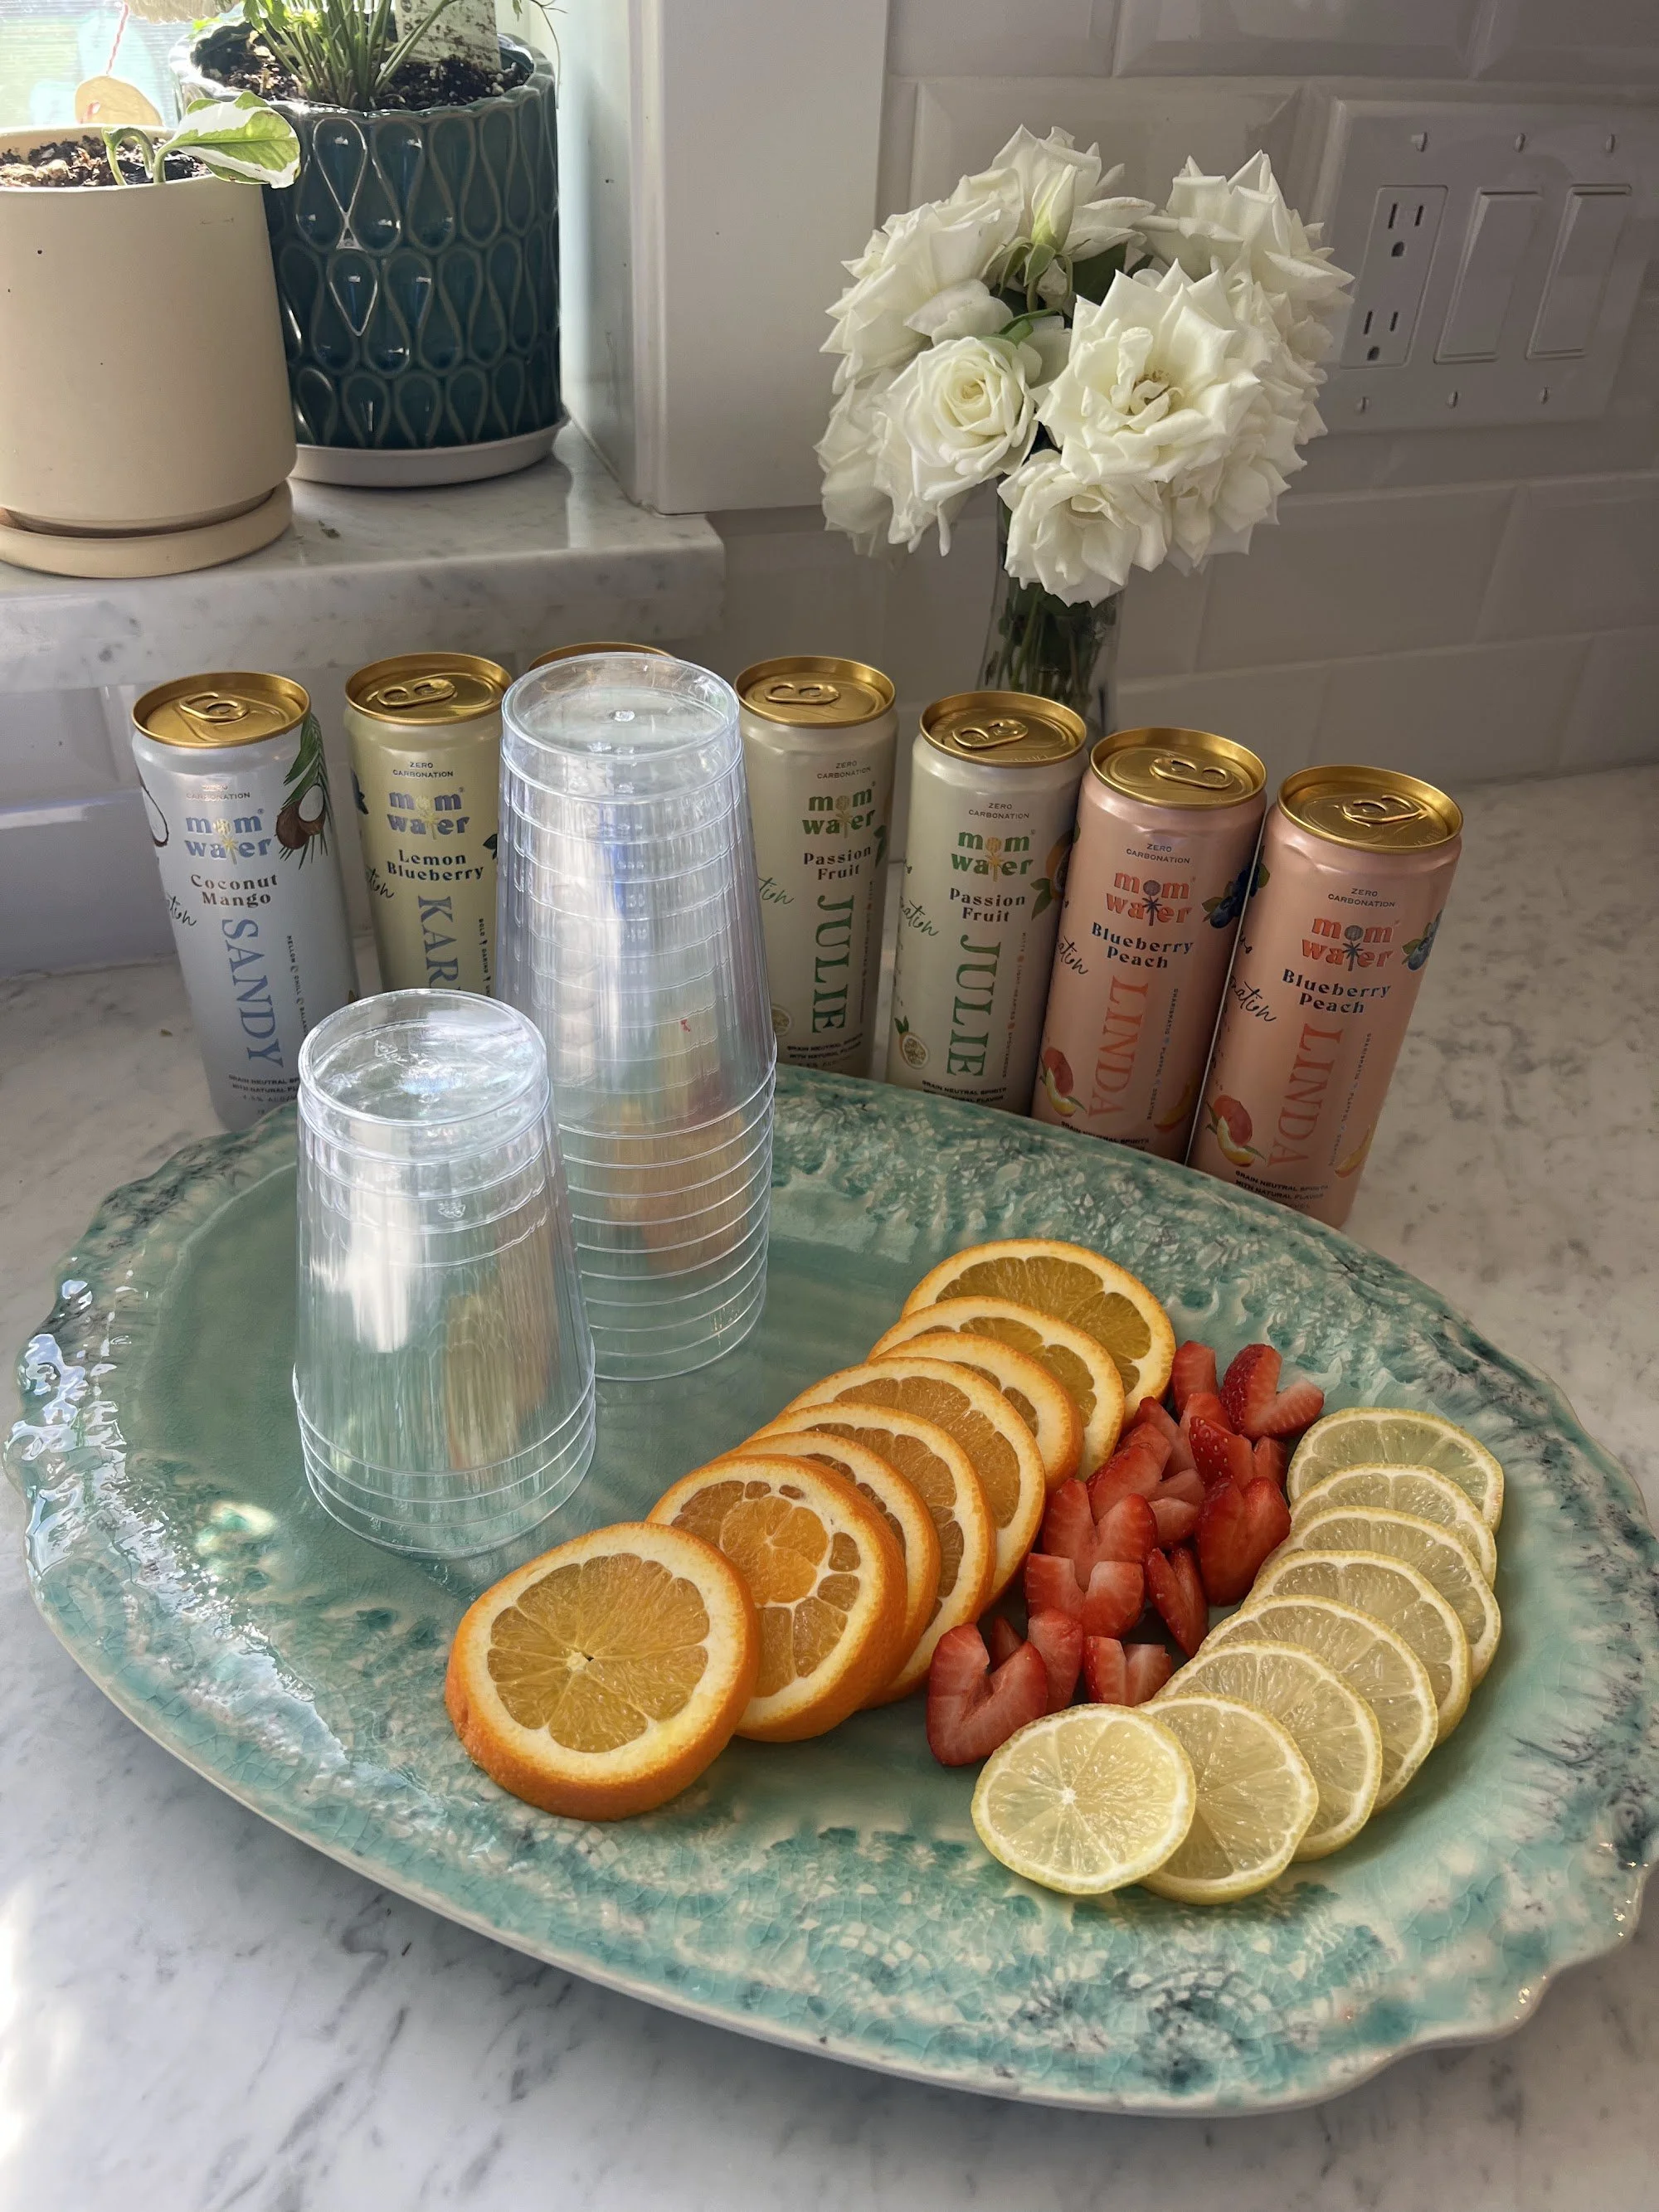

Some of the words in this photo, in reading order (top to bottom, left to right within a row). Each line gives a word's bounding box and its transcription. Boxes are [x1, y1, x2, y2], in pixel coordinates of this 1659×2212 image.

[392, 770, 454, 778] CARBONATION
[817, 766, 871, 780] CARBONATION
[835, 761, 858, 769] ZERO
[186, 792, 251, 801] CARBONATION
[802, 809, 875, 838] water
[969, 809, 1029, 819] CARBONATION
[387, 814, 470, 839] water
[184, 837, 272, 864] water
[399, 849, 466, 866] Lemon
[804, 846, 871, 865] Passion
[1126, 848, 1190, 864] CARBONATION
[1146, 843, 1172, 853] ZERO
[387, 861, 484, 882] Blueberry
[817, 864, 859, 880] Fruit
[951, 853, 1034, 882] water
[191, 874, 278, 890] Coconut
[202, 892, 271, 909] Mango
[949, 887, 1025, 907] Passion
[1328, 893, 1395, 907] CARBONATION
[1351, 888, 1378, 897] ZERO
[962, 907, 1010, 922] Fruit
[1107, 893, 1192, 926] water
[418, 896, 460, 989] KAR
[1092, 921, 1194, 954] Blueberry
[812, 895, 854, 1033] JULIE
[1107, 946, 1168, 969] Peach
[1301, 939, 1394, 971] water
[222, 919, 284, 1068] SANDY
[1282, 969, 1391, 998] Blueberry
[946, 934, 1001, 1076] JULIE
[1299, 993, 1365, 1014] Peach
[1088, 975, 1149, 1118] LINDA
[944, 1087, 978, 1096] NEUTRAL
[1267, 1023, 1344, 1168] LINDA
[1235, 1170, 1258, 1184] GRAIN
[1259, 1181, 1297, 1192] NEUTRAL
[1255, 1187, 1292, 1199] NATURAL
